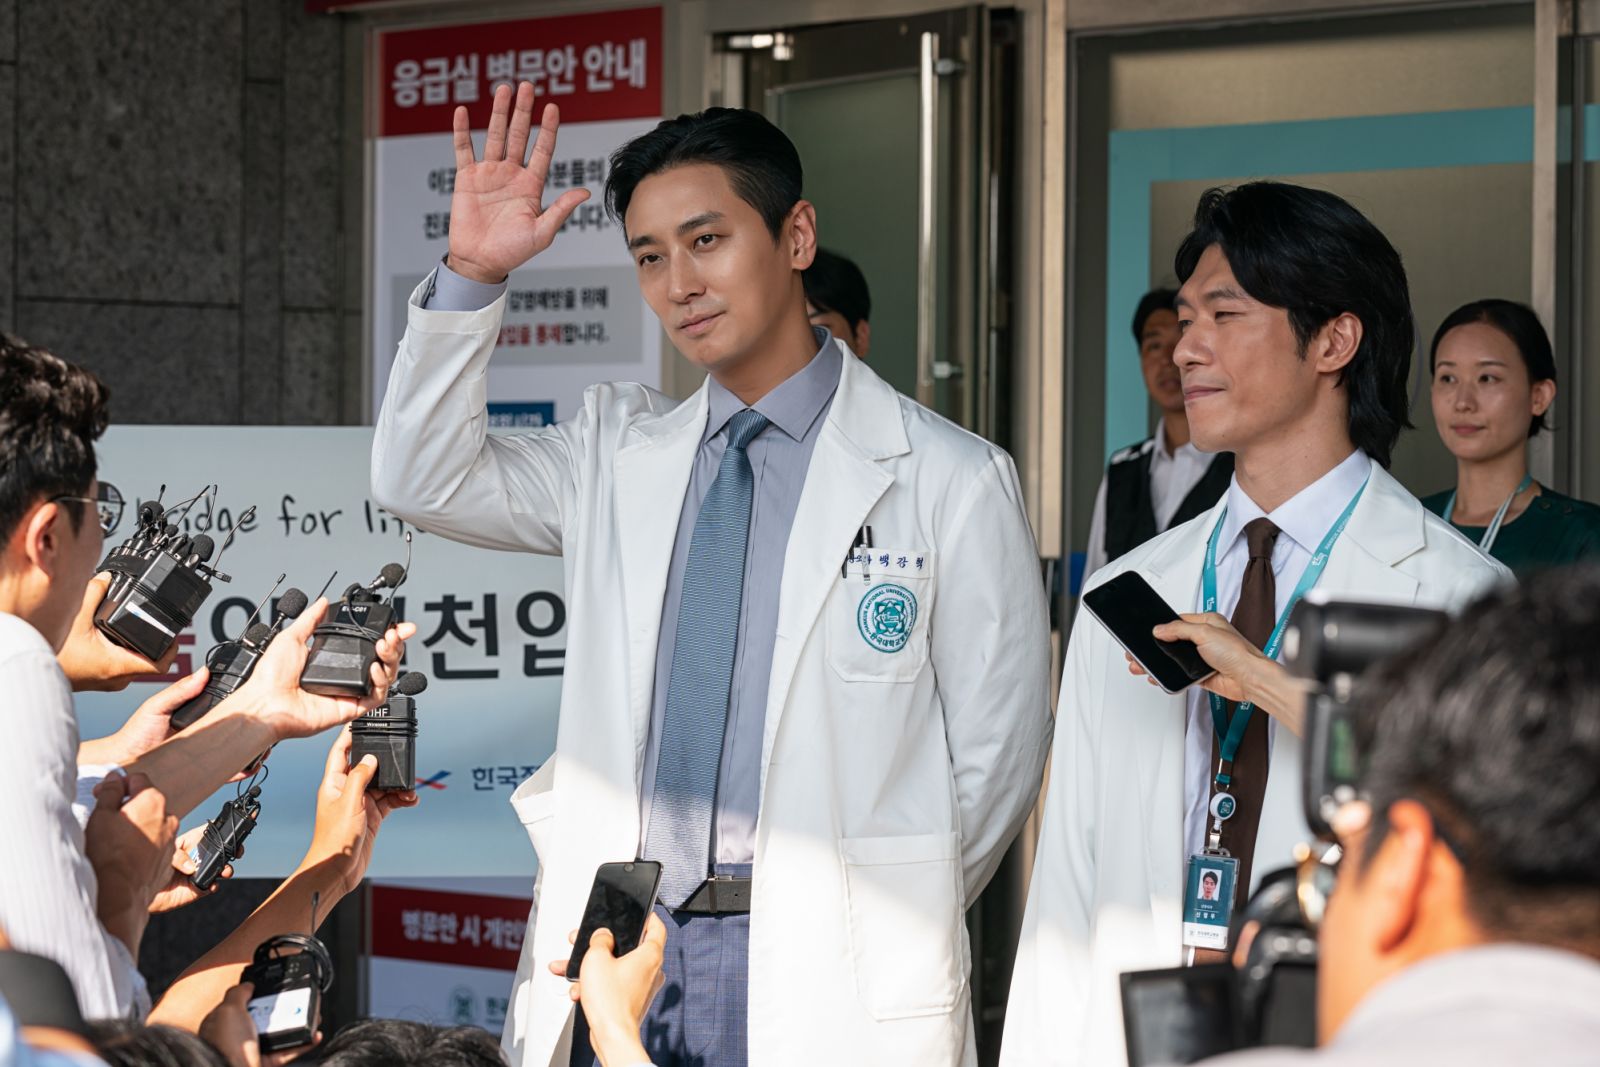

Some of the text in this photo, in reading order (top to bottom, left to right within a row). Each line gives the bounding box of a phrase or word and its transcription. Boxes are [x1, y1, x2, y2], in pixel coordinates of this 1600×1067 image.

[392, 38, 647, 107] 응급실 병문안 안내
[546, 157, 605, 189] 분들의
[278, 494, 342, 537] for
[402, 909, 528, 951] 병문안 시 개인
